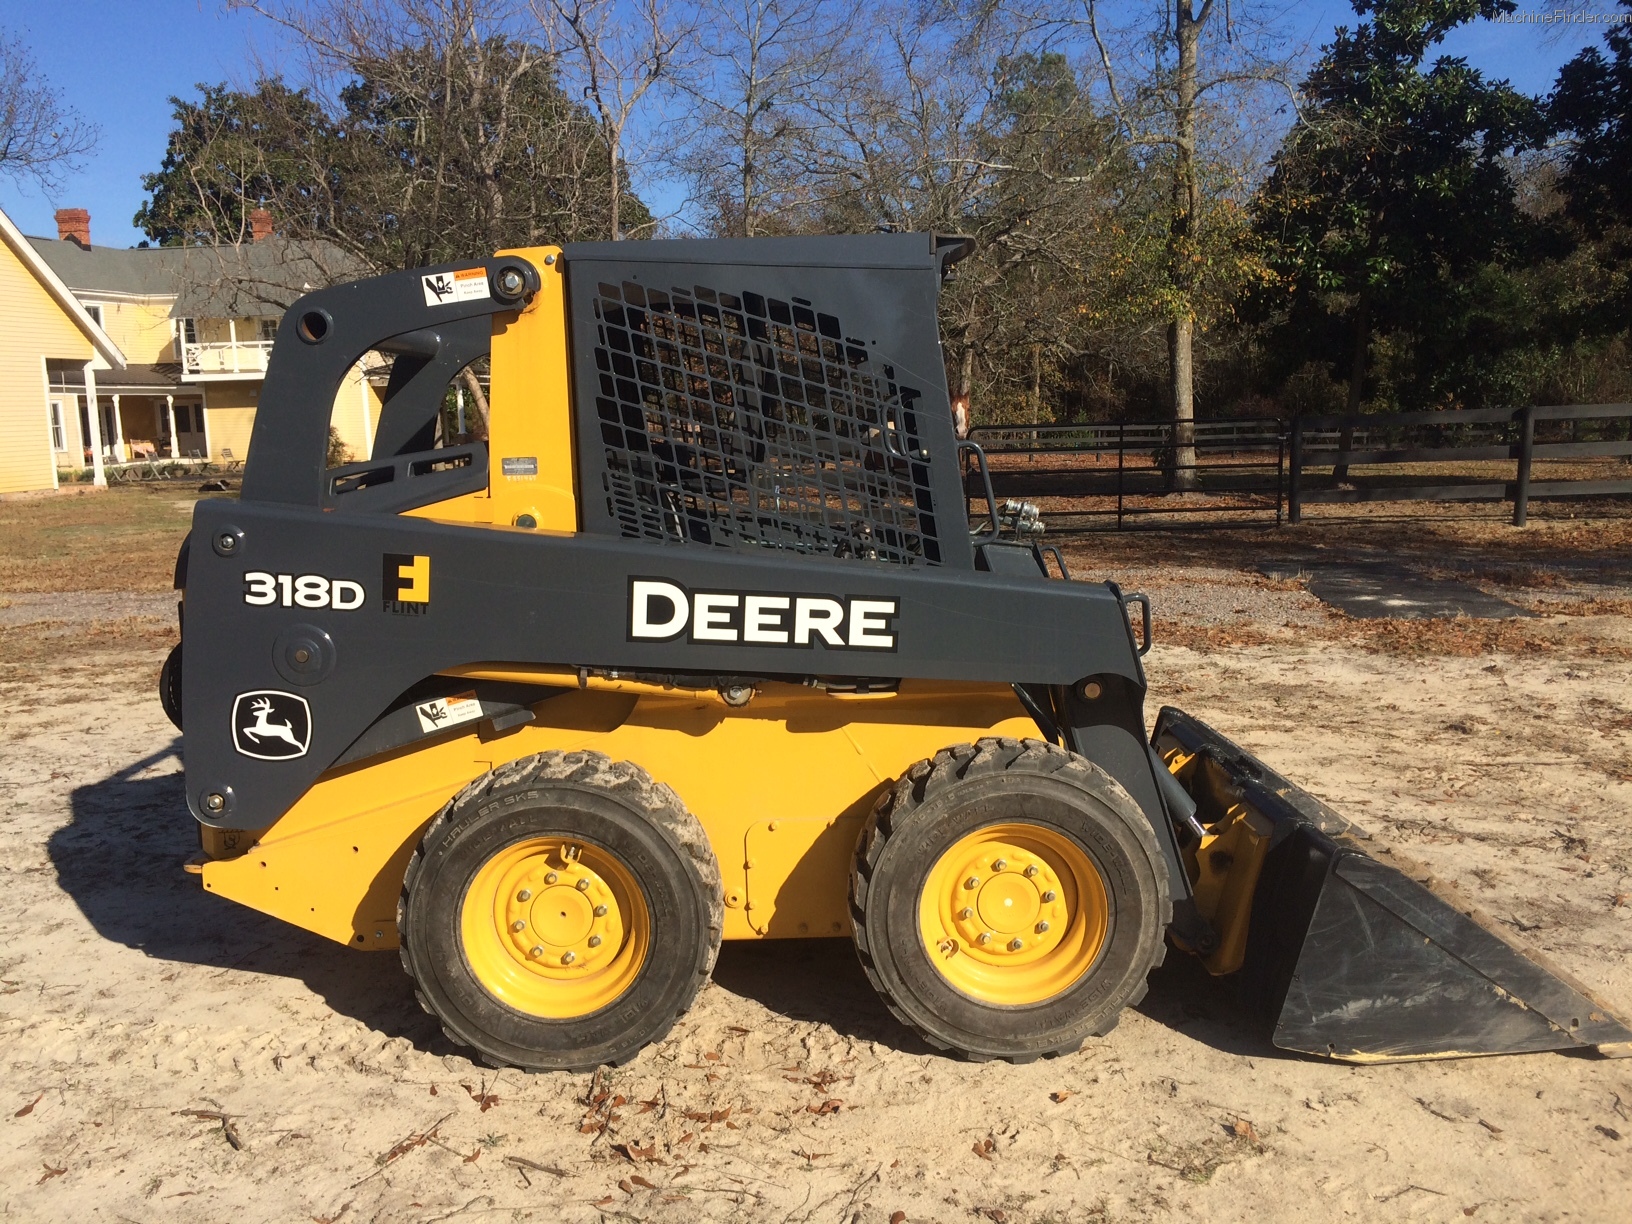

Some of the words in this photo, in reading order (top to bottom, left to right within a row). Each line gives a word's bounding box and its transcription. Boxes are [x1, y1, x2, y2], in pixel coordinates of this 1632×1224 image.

[244, 571, 366, 611] 318D
[382, 601, 429, 616] FLINT
[630, 579, 897, 649] DEERE
[442, 801, 500, 848] HAULER
[503, 790, 540, 806] SKS
